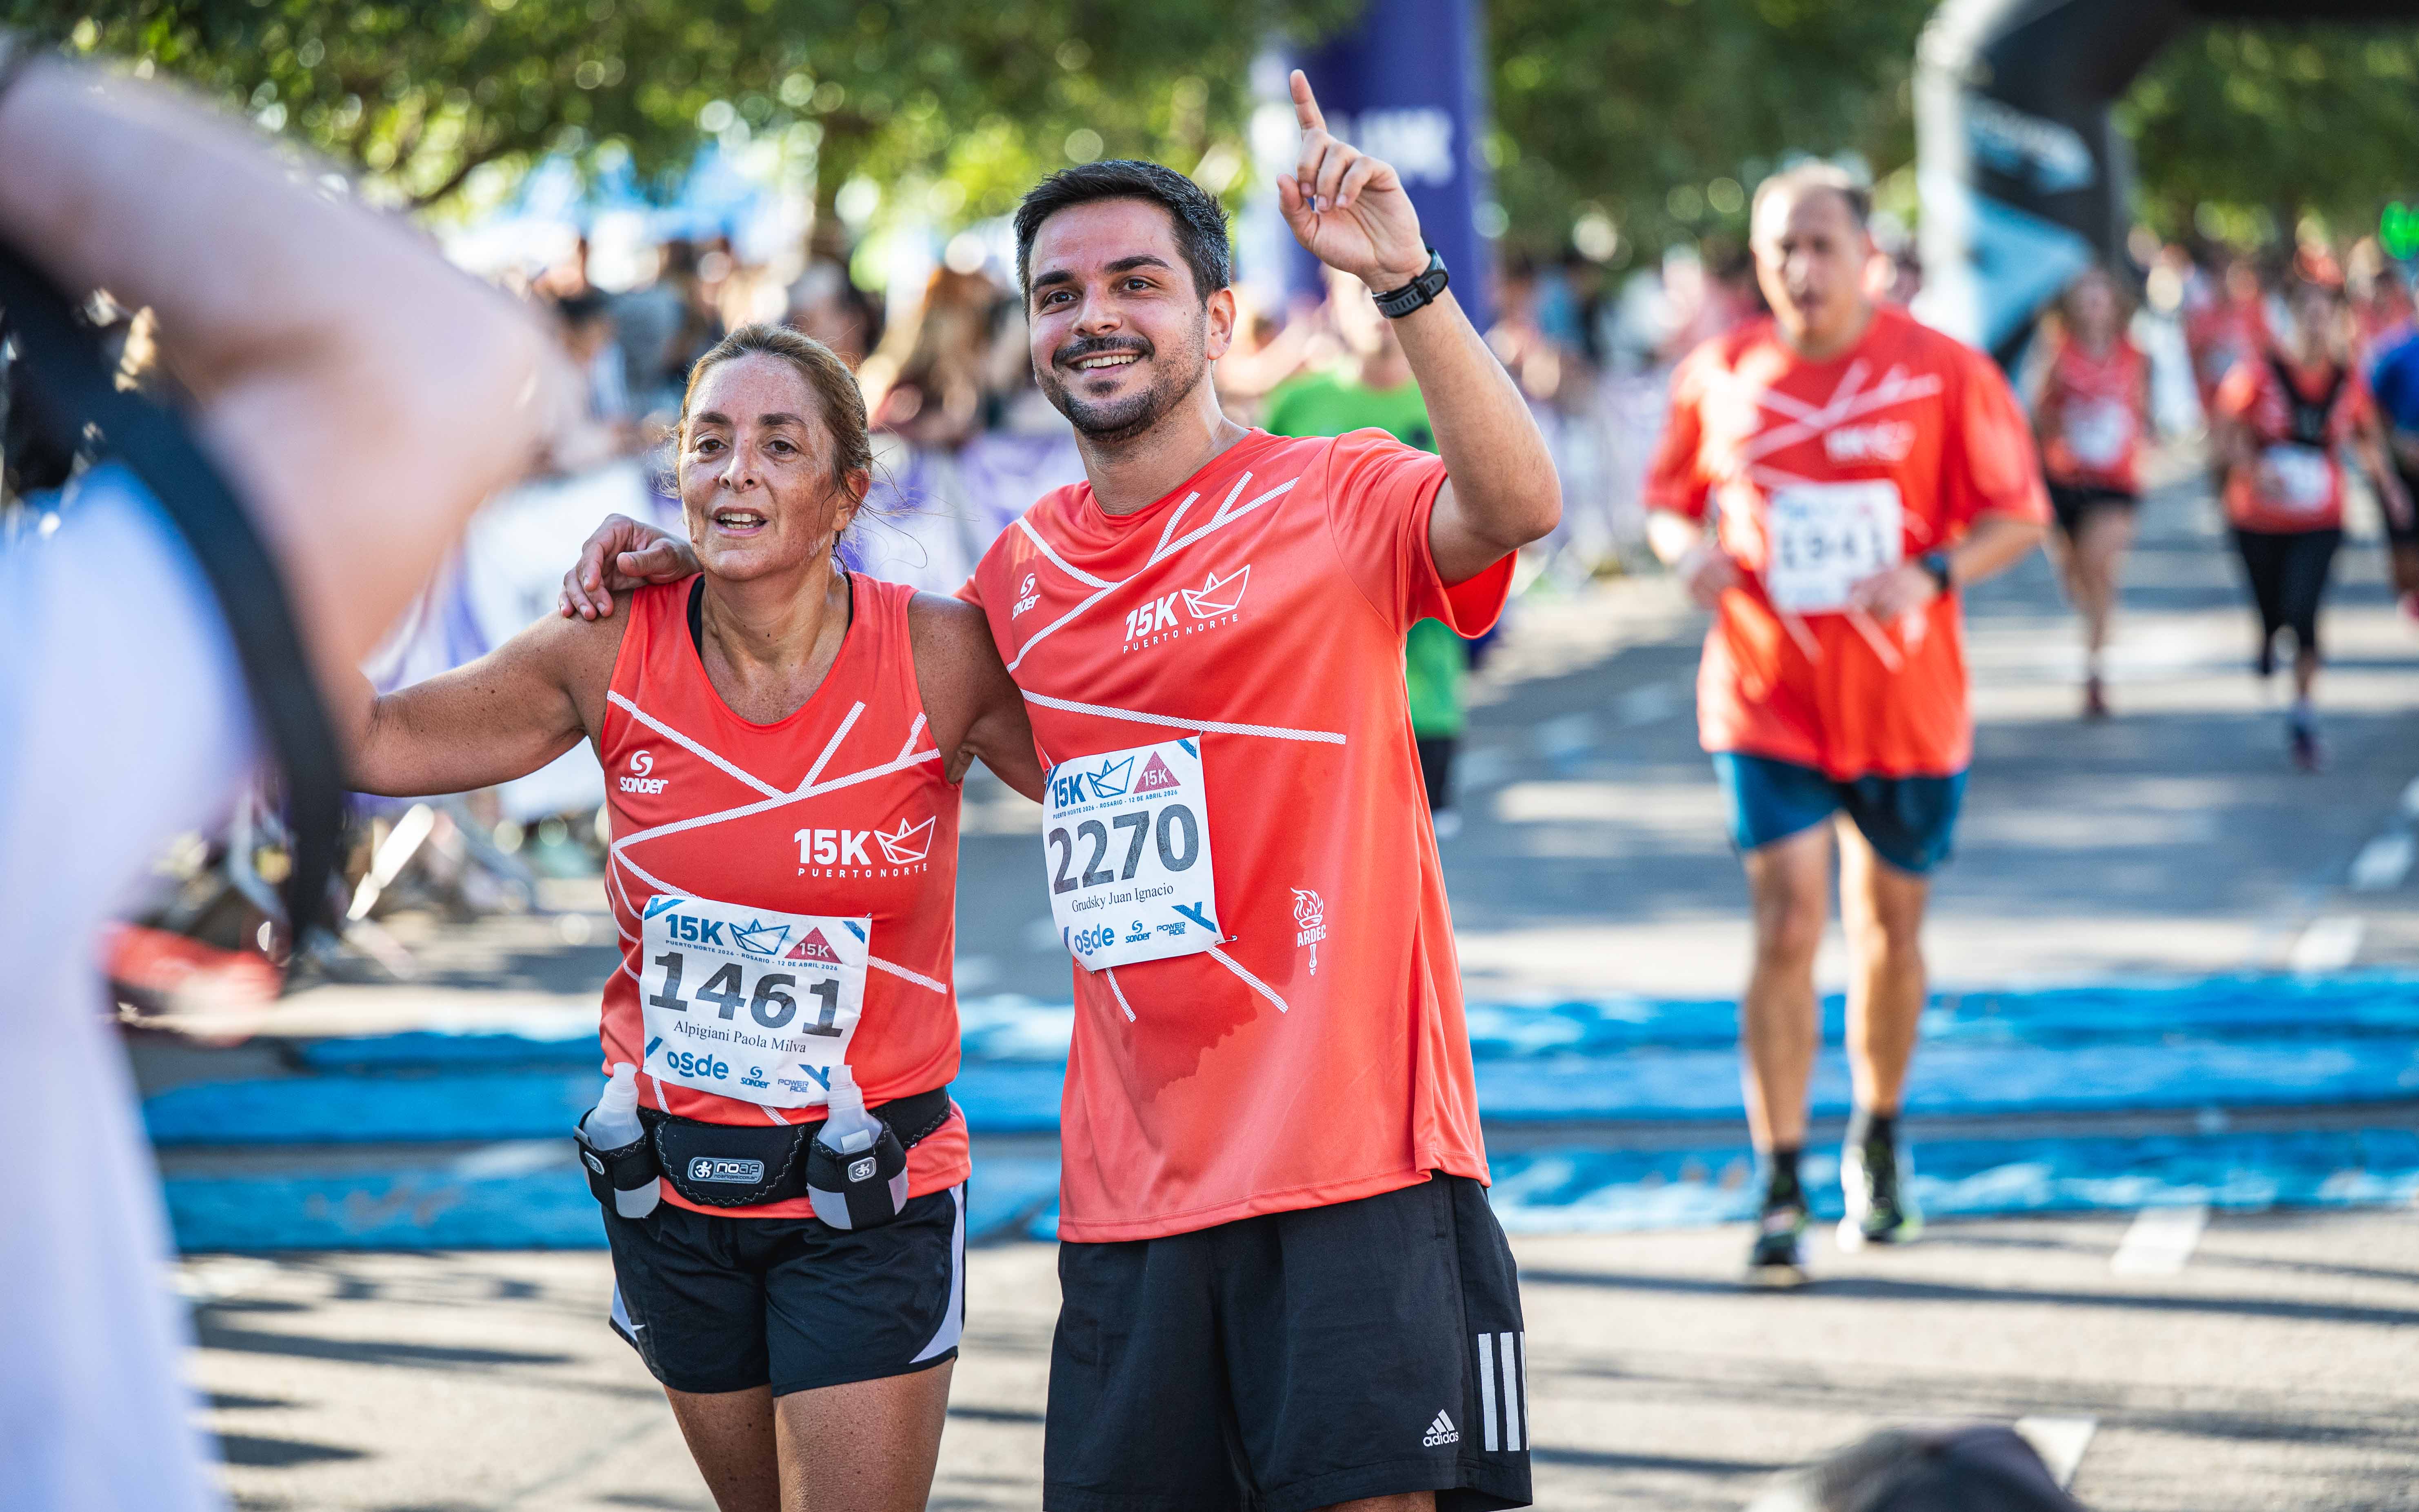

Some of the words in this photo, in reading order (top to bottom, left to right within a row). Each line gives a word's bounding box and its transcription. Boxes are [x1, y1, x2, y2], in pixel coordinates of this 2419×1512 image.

[1125, 591, 1179, 642] 15K
[1123, 630, 1179, 654] PUERTO
[1186, 613, 1238, 635] NORTE
[1053, 773, 1086, 809] 15K
[1143, 768, 1168, 786] 15K
[1053, 811, 1066, 819] PUERTO
[1100, 799, 1122, 809] ROSARIO
[794, 829, 871, 865] 15K
[1049, 804, 1199, 895] 2270
[798, 868, 872, 878] PUERTO
[880, 863, 927, 877] NORTE
[1072, 895, 1106, 912] Grudsky
[1109, 892, 1132, 904] Juan
[1135, 883, 1173, 903] Ignacio
[666, 914, 724, 946] 15K
[1074, 923, 1115, 956] osde
[1157, 922, 1185, 932] POWER
[1297, 924, 1326, 947] ARDEC
[666, 940, 692, 948] PUERTO
[693, 944, 715, 952] NORTE
[741, 953, 769, 964] ROSARIO
[800, 942, 829, 958] 15K
[649, 951, 844, 1038] 1461
[673, 1020, 730, 1041] Alpigiani
[734, 1030, 766, 1048] Paola
[771, 1037, 806, 1052] Milva
[667, 1051, 729, 1080] osde
[1423, 1430, 1459, 1447] adidas
